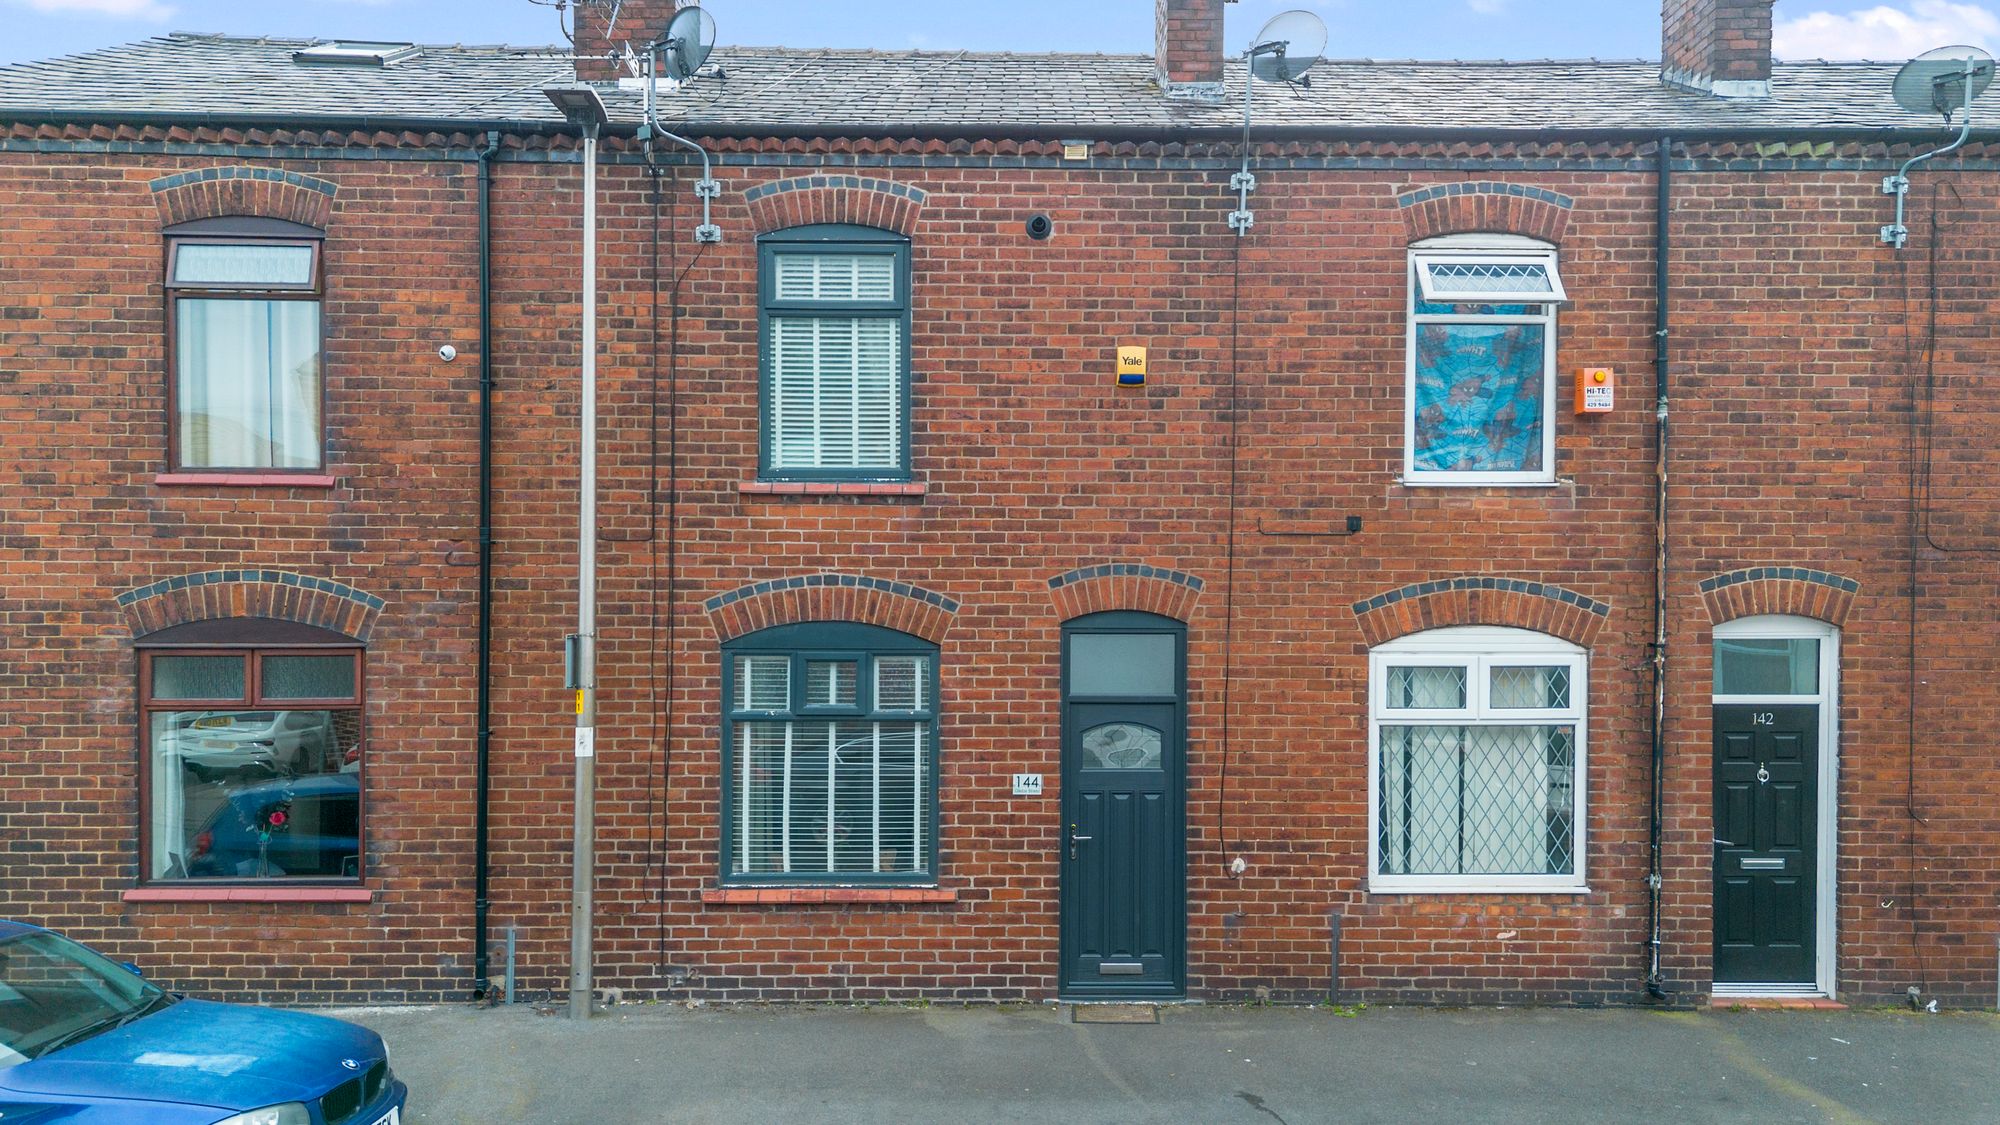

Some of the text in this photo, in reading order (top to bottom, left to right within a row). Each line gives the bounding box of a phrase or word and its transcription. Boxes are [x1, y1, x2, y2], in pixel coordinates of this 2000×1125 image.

[1122, 356, 1142, 366] Yale
[1753, 712, 1774, 725] 142
[1016, 775, 1039, 788] 144
